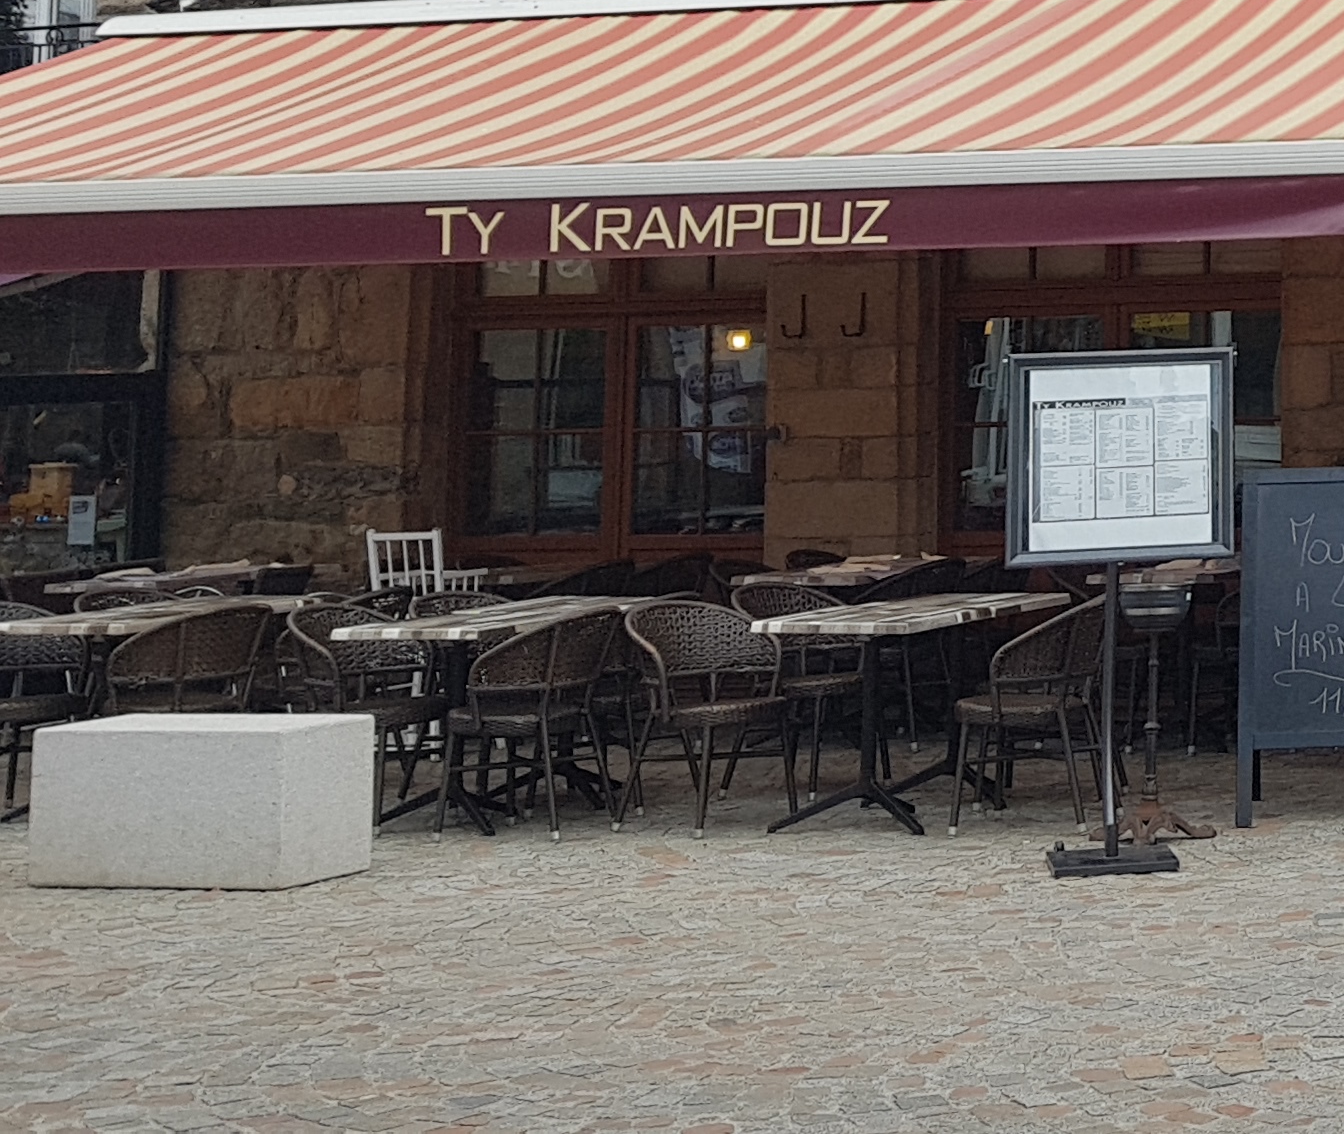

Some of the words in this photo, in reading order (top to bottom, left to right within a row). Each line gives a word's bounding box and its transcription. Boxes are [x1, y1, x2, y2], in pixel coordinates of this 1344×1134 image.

[425, 205, 505, 255] TY
[549, 199, 891, 252] KRAMPOUZ
[1296, 581, 1310, 613] A
